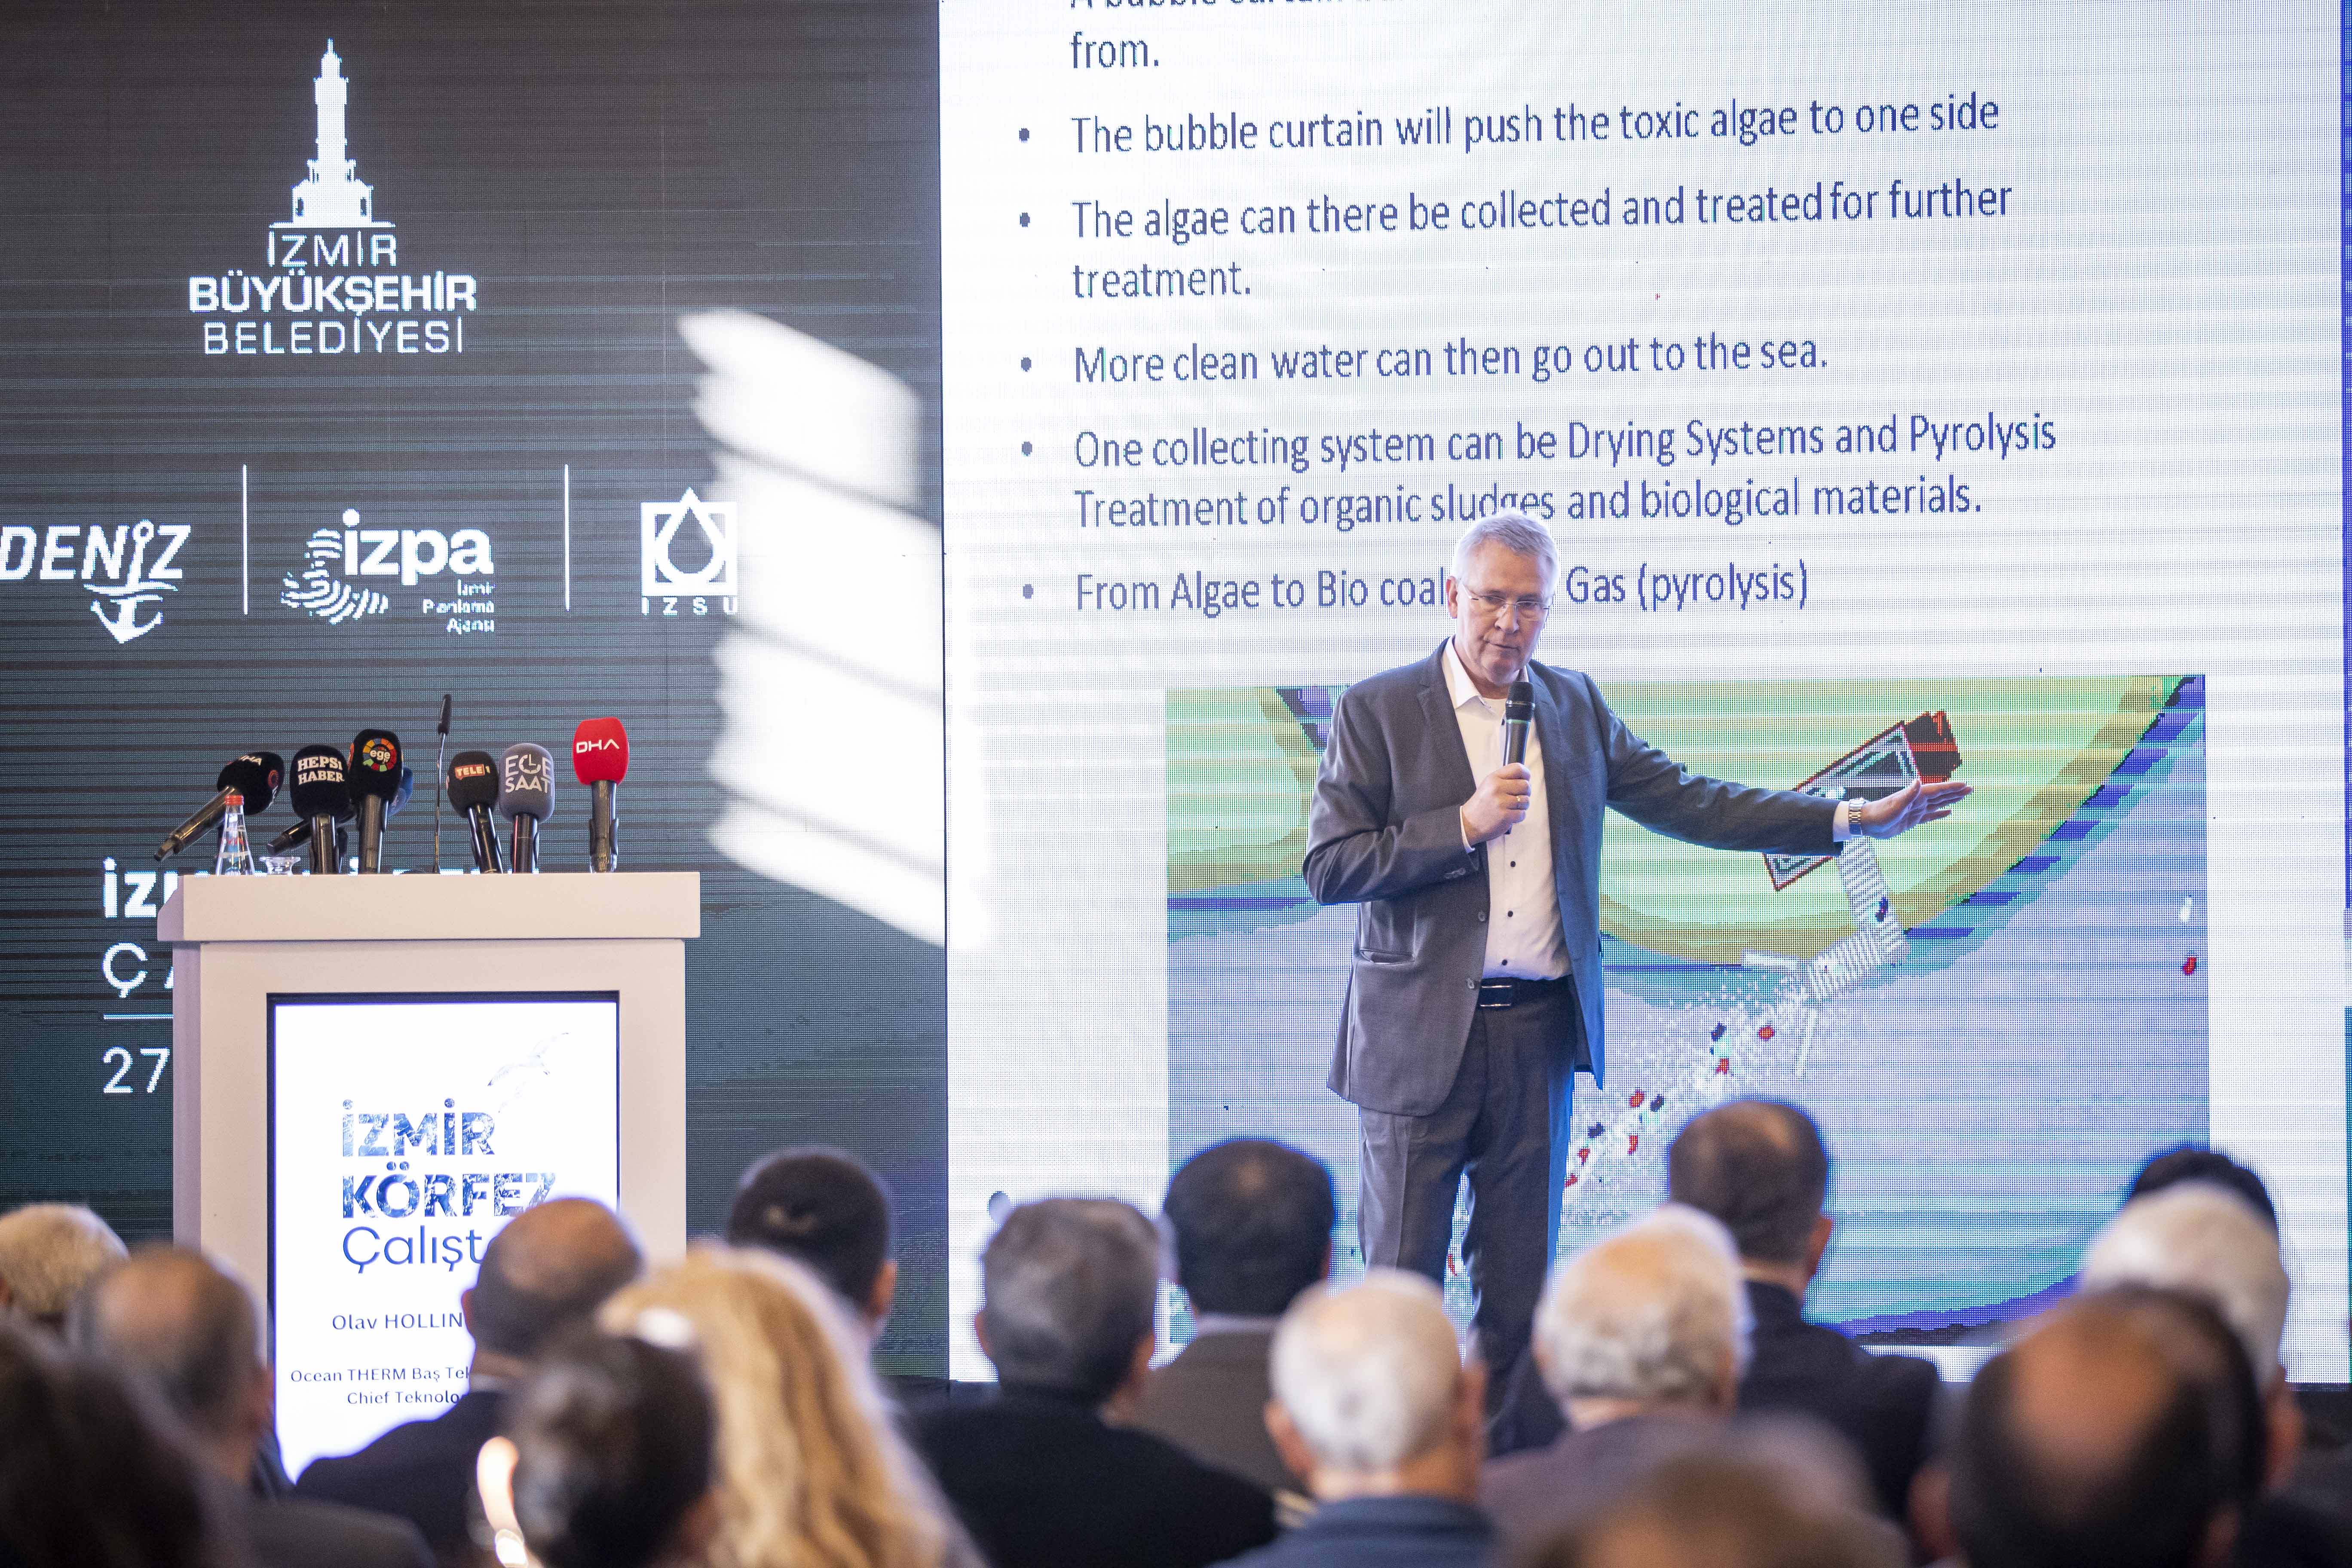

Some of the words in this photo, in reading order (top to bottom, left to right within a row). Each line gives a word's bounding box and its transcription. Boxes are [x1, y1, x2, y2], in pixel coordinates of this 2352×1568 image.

[1071, 31, 1159, 69] from.
[1072, 116, 1132, 152] The
[1146, 112, 1257, 151] bubble
[1270, 111, 1382, 149] curtain
[1396, 105, 1451, 145] will
[1465, 103, 1542, 153] push
[1555, 103, 1609, 141] the
[1620, 101, 1698, 139] toxic
[1711, 98, 1796, 146] algae
[1810, 100, 1844, 135] to
[1856, 103, 1919, 132] one
[1930, 92, 1999, 130] side
[1072, 200, 1133, 237] The
[1145, 199, 1228, 245] algae
[1242, 205, 1295, 234] can
[1307, 194, 1397, 232] there
[1411, 193, 1449, 230] be
[1462, 188, 1609, 229] collected
[1623, 186, 1684, 224] and
[1697, 182, 1821, 224] treated
[1830, 181, 1879, 220] for
[1890, 178, 2012, 218] further
[267, 231, 397, 267] İZMİR
[189, 269, 477, 316] BÜYÜKŞEHİR
[1072, 262, 1250, 298] treatment.
[204, 315, 462, 354] BELEDİYESİ
[1075, 347, 1164, 383] More
[1174, 343, 1257, 381] clean
[1272, 346, 1368, 378] water
[1377, 348, 1430, 376] can
[1444, 337, 1519, 376] then
[1533, 345, 1571, 382] go
[1584, 338, 1639, 372] out
[1650, 337, 1684, 371] to
[1695, 332, 1750, 370] the
[1761, 341, 1827, 368] sea.
[1075, 431, 1142, 467] One
[1153, 428, 1309, 473] collecting
[1321, 429, 1434, 472] system
[1449, 430, 1504, 460] can
[1518, 422, 1556, 459] be
[1569, 421, 1675, 467] Drying
[1687, 420, 1824, 465] Systems
[1836, 414, 1896, 454] and
[1910, 412, 2055, 461] Pyrolysis
[1075, 490, 1248, 527] Treatment
[1258, 486, 1290, 524] of
[1301, 485, 1421, 531] organic
[1568, 480, 1629, 519] and
[1641, 478, 1799, 525] biological
[1814, 474, 1981, 514] materials.
[343, 508, 493, 585] izpa
[1078, 574, 1158, 610] From
[1171, 571, 1259, 618] Algae
[1272, 574, 1305, 609] to
[1318, 570, 1368, 608] Bio
[1381, 567, 1444, 607] coal
[1566, 565, 1626, 603] Gas
[1638, 559, 1807, 612] (pyrolysis)
[576, 739, 619, 753] DHA
[298, 771, 345, 785] HABER
[103, 1046, 170, 1093] 27
[343, 1098, 495, 1157] İZMİR
[333, 1314, 377, 1330] Olav
[386, 1313, 462, 1329] HOLLIN
[291, 1370, 342, 1382] Ocean
[348, 1368, 406, 1381] THERM
[413, 1367, 440, 1382] Baş
[348, 1390, 390, 1405] Chief
